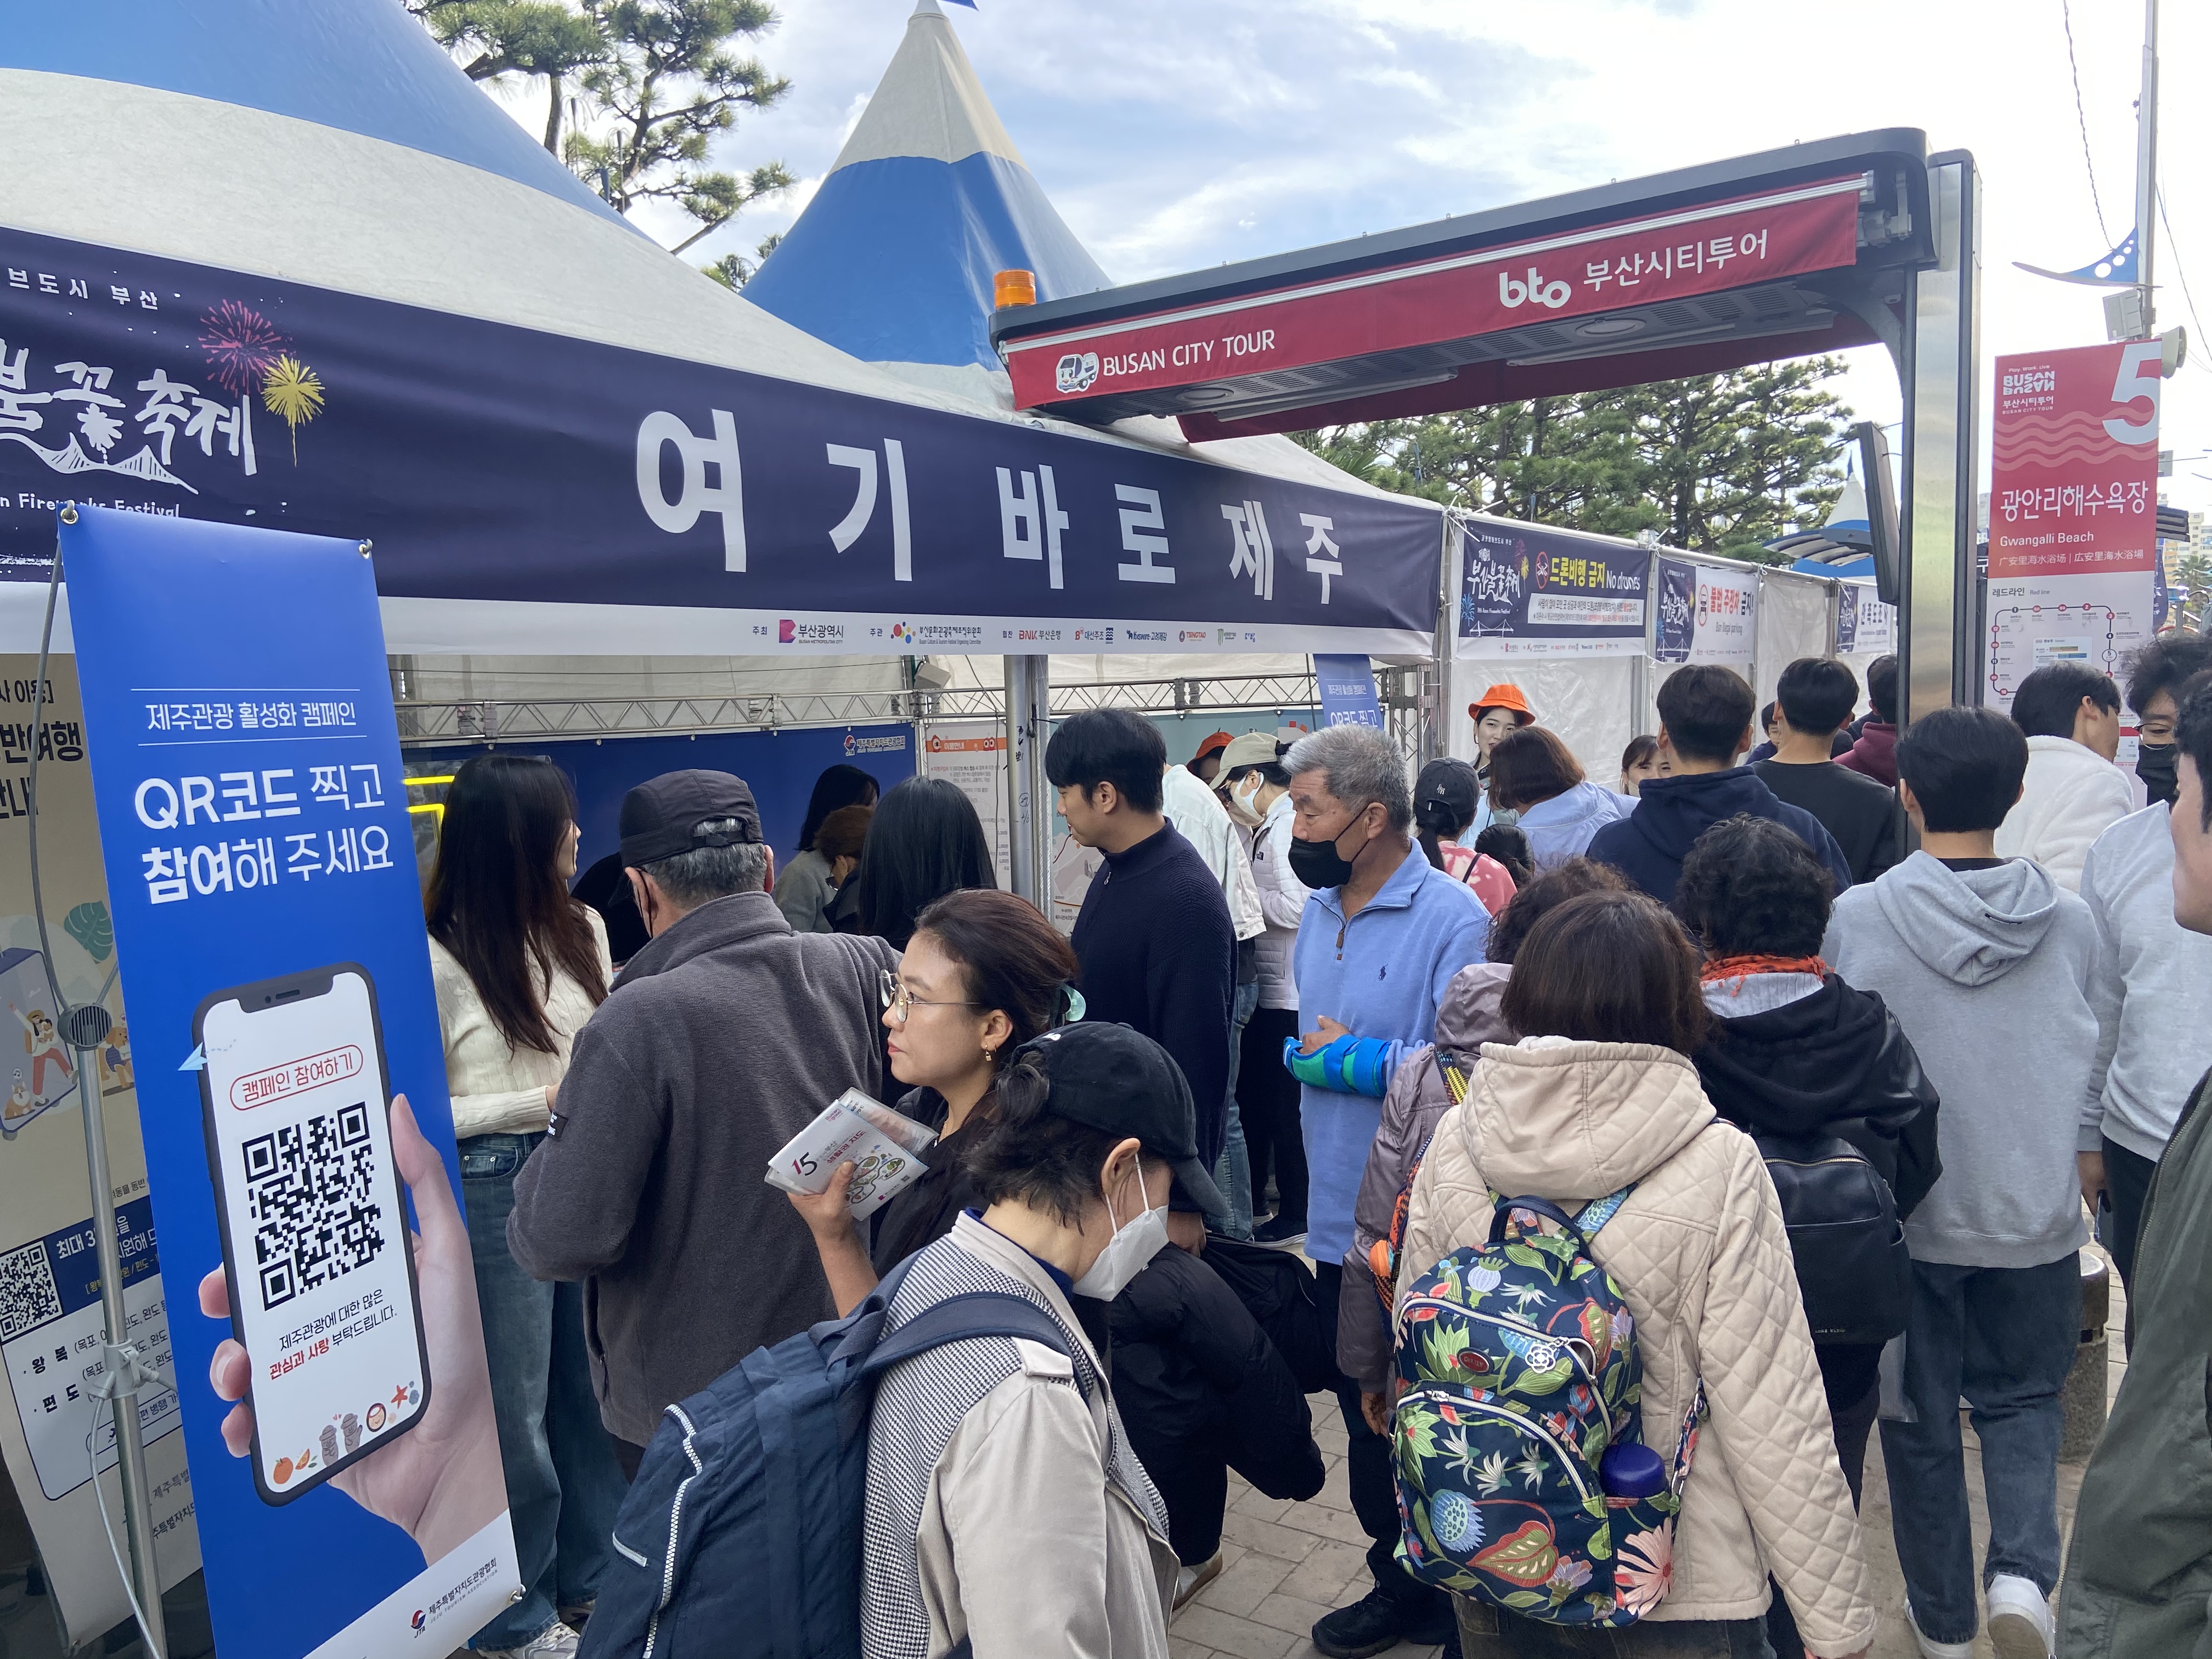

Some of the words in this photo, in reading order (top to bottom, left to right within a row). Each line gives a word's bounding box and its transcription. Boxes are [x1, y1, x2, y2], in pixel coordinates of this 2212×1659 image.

[1584, 229, 1768, 291] 부산시티투어
[110, 285, 159, 311] 부산
[1499, 267, 1571, 308] bto
[1103, 348, 1165, 376] BUSAN
[1172, 340, 1214, 366] CITY
[1222, 329, 1275, 358] TOUR
[2003, 371, 2055, 387] BUSAN
[2102, 338, 2162, 445] 5
[2002, 396, 2053, 409] 부산시티투어
[2000, 481, 2149, 522] 광안리해수욕장
[2000, 533, 2055, 547] Gwangalli
[2058, 532, 2094, 543] Beach
[1999, 553, 2066, 566] 广安里海水浴场
[1549, 557, 1587, 587] 드론비행
[1588, 561, 1606, 589] 금지
[1606, 570, 1616, 589] No
[1711, 586, 1722, 613] 불법
[1724, 589, 1740, 614] 주정차
[1993, 587, 2025, 597] 레드라인
[752, 626, 768, 635] 주최
[798, 624, 844, 638] 부산광역시
[870, 628, 883, 637] 주관
[1019, 630, 1037, 640] BNK
[1039, 630, 1061, 640] 부산은행
[1085, 631, 1104, 640] 대선주조
[145, 703, 234, 731] 제주관광
[239, 702, 297, 729] 활성화
[302, 701, 357, 726] 캠페인
[135, 769, 302, 830] QR코드
[309, 764, 386, 811] 찍고
[142, 837, 278, 905] 참여해
[285, 825, 394, 882] 주세요
[242, 1070, 290, 1103] 캠페인
[294, 1052, 353, 1087] 참여하기
[848, 1130, 866, 1144] 지도
[791, 1152, 818, 1176] 15
[56, 1234, 84, 1260] 최대
[142, 1304, 161, 1321] 완도
[279, 1311, 337, 1352] 제주관광에
[338, 1300, 360, 1322] 대한
[362, 1288, 383, 1309] 많은
[150, 1329, 168, 1347] 완도
[269, 1350, 305, 1380] 관심과
[308, 1337, 330, 1360] 사랑
[332, 1305, 397, 1346] 부탁드립니다.
[429, 1558, 497, 1615] 제주특별자치도관광협회
[431, 1612, 442, 1624] JEJU
[444, 1594, 466, 1612] TOURISM
[467, 1569, 498, 1595] ASSOCIATION
[414, 1625, 426, 1639] JTA
